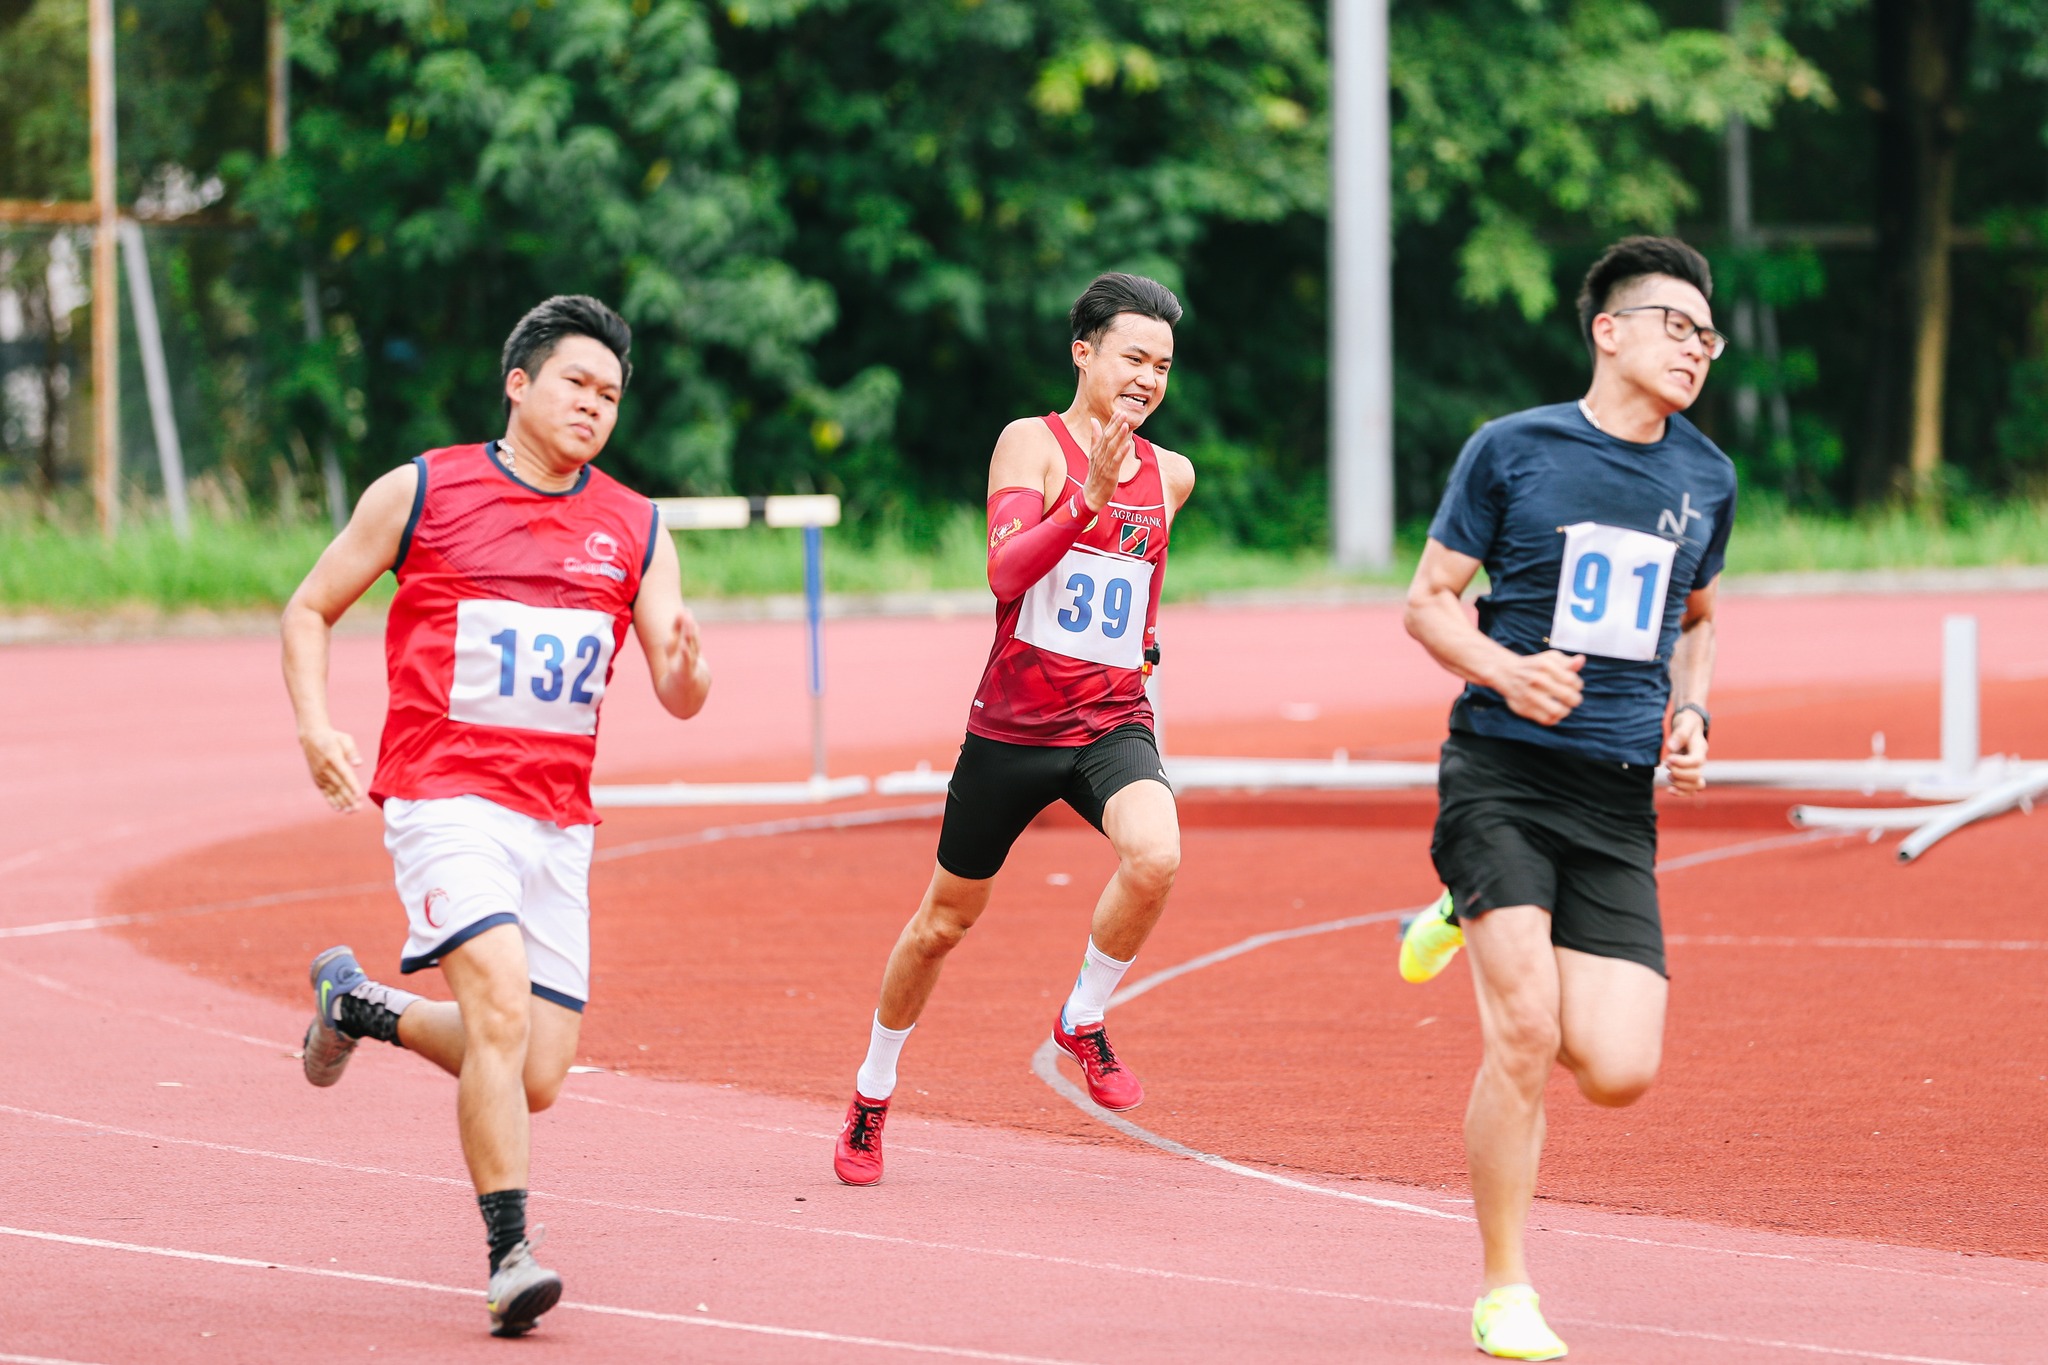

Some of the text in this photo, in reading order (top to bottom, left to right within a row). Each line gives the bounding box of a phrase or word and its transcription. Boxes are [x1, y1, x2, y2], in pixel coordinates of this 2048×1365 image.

[1110, 508, 1162, 528] AGRIBANK
[1057, 572, 1133, 639] 39
[1570, 552, 1660, 631] 91
[490, 629, 602, 705] 132
